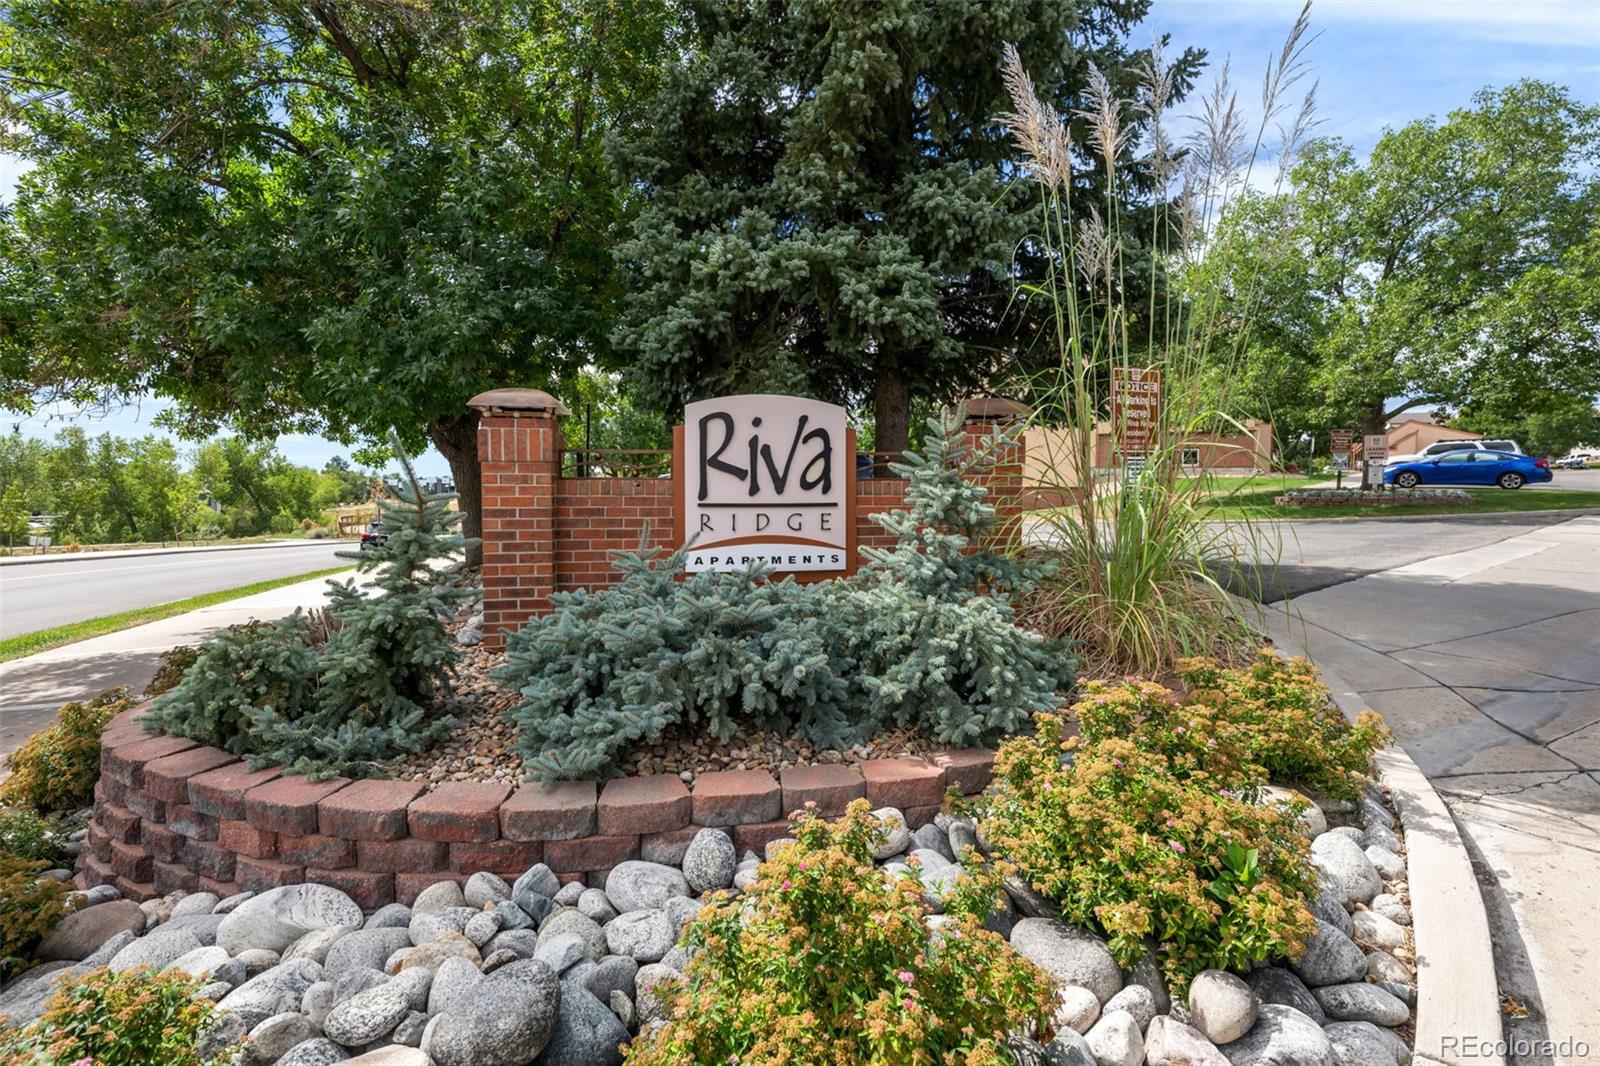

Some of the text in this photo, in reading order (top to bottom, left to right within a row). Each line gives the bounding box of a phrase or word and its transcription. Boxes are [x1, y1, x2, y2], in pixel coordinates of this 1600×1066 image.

[1118, 382, 1155, 392] NOTICE
[698, 411, 832, 501] Riva
[700, 513, 832, 533] RIDGE
[694, 554, 840, 566] APARTMENTS
